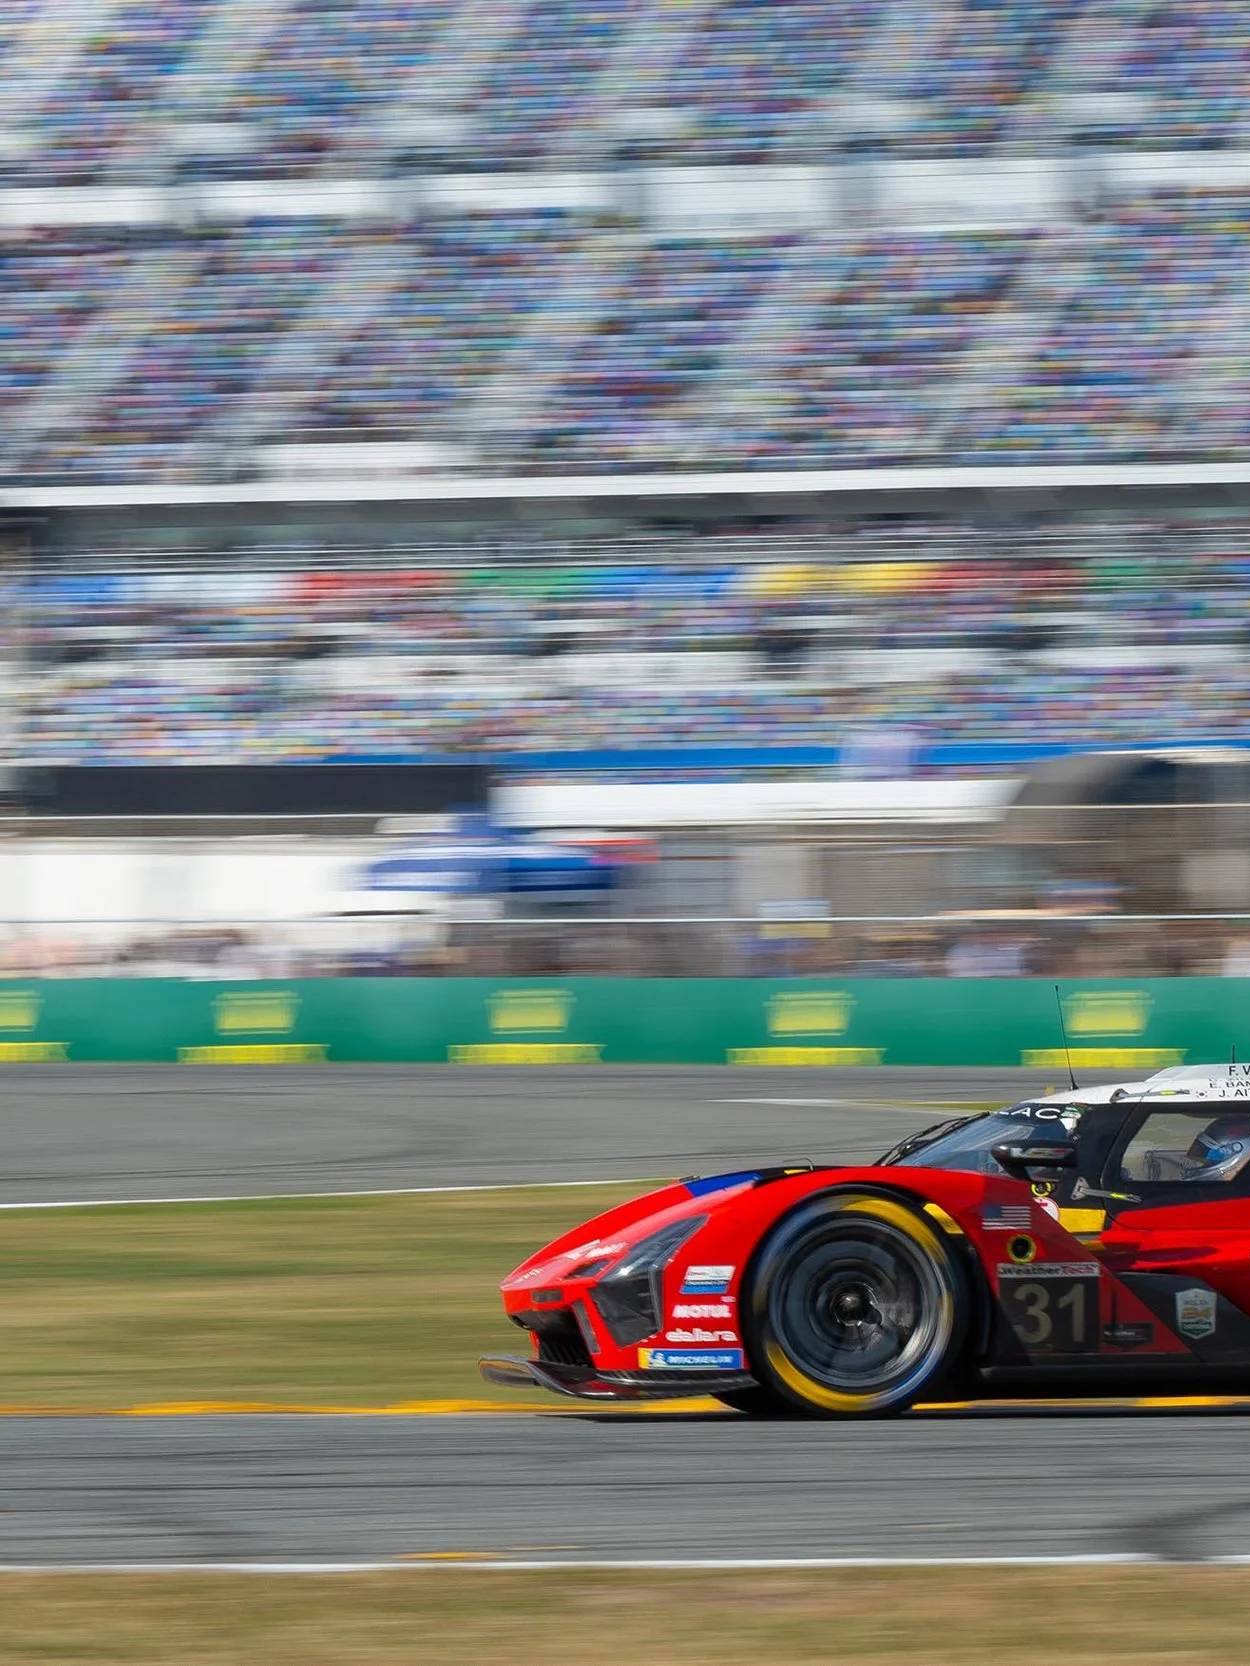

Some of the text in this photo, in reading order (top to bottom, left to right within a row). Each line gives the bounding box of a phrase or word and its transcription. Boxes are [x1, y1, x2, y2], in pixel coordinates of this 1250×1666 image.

[1229, 1065, 1239, 1076] F.
[1218, 1089, 1230, 1098] J.
[1013, 1282, 1086, 1344] 31
